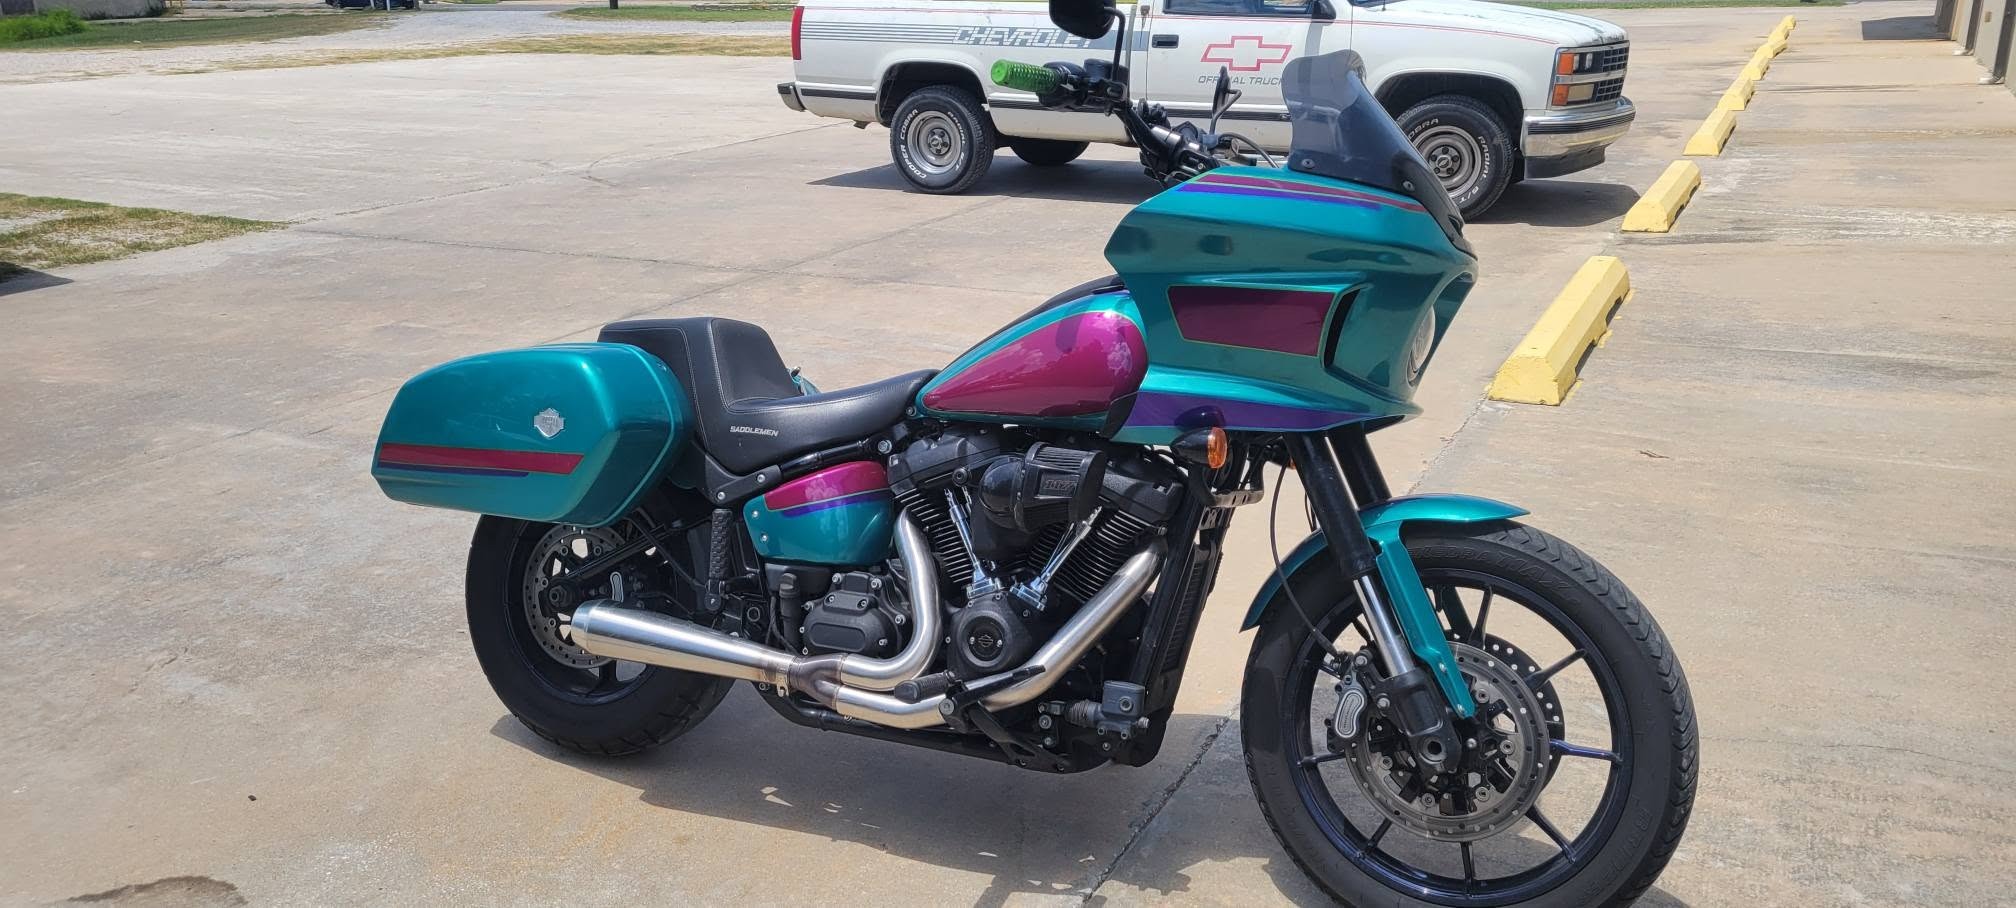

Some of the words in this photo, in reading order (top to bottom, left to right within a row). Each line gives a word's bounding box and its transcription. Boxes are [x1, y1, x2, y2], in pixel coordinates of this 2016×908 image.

[900, 108, 919, 140] COBRA
[900, 144, 927, 179] COOPER
[1408, 118, 1439, 140] OBRA
[1478, 135, 1490, 178] RADIAL
[729, 425, 779, 437] SADDLEMEN
